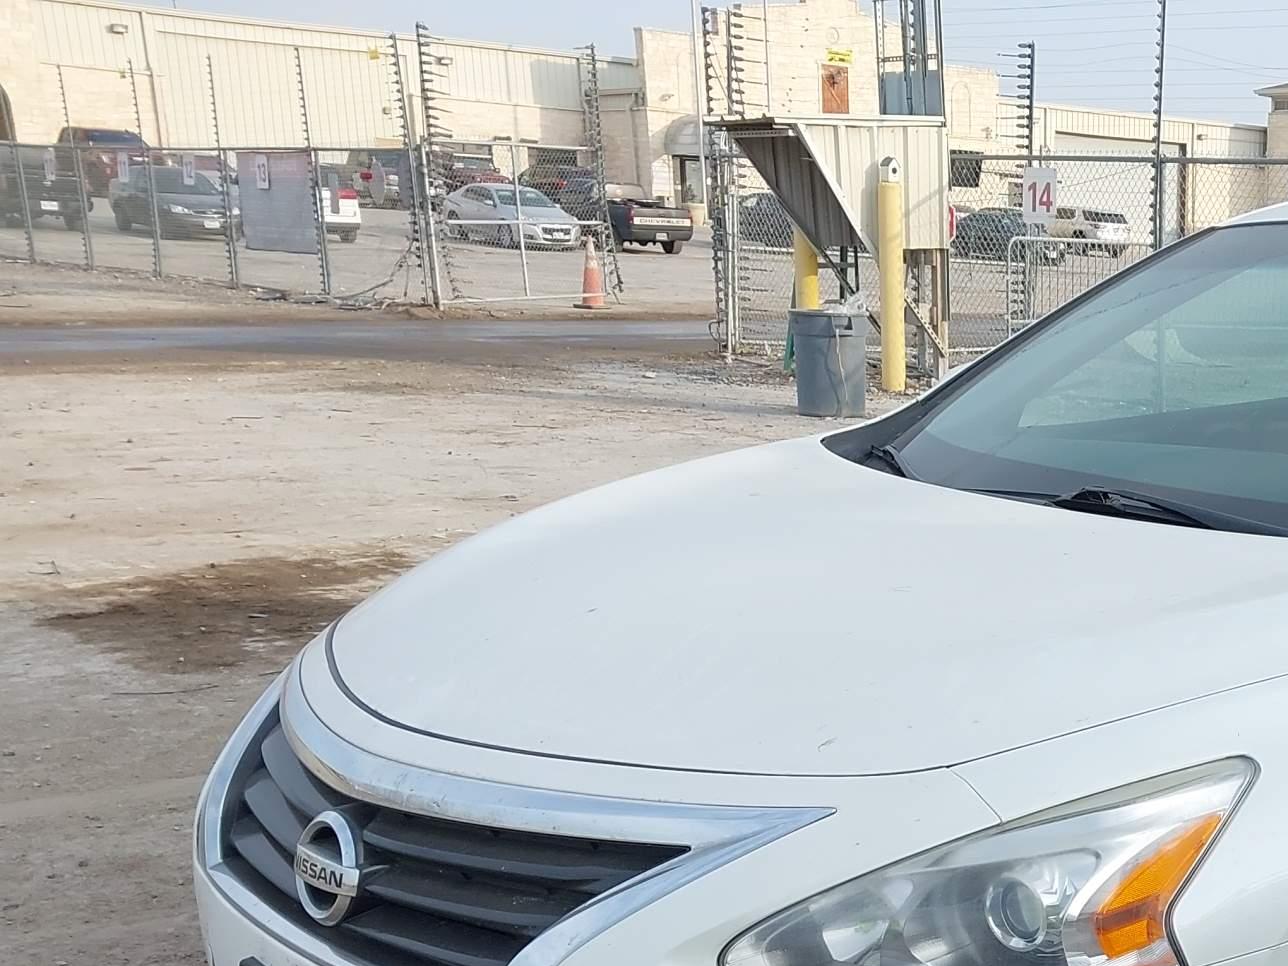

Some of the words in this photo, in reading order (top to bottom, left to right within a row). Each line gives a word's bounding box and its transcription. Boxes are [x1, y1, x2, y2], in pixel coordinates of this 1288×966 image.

[257, 162, 267, 183] 13
[1028, 182, 1053, 213] 14
[296, 855, 344, 889] NISSAN
